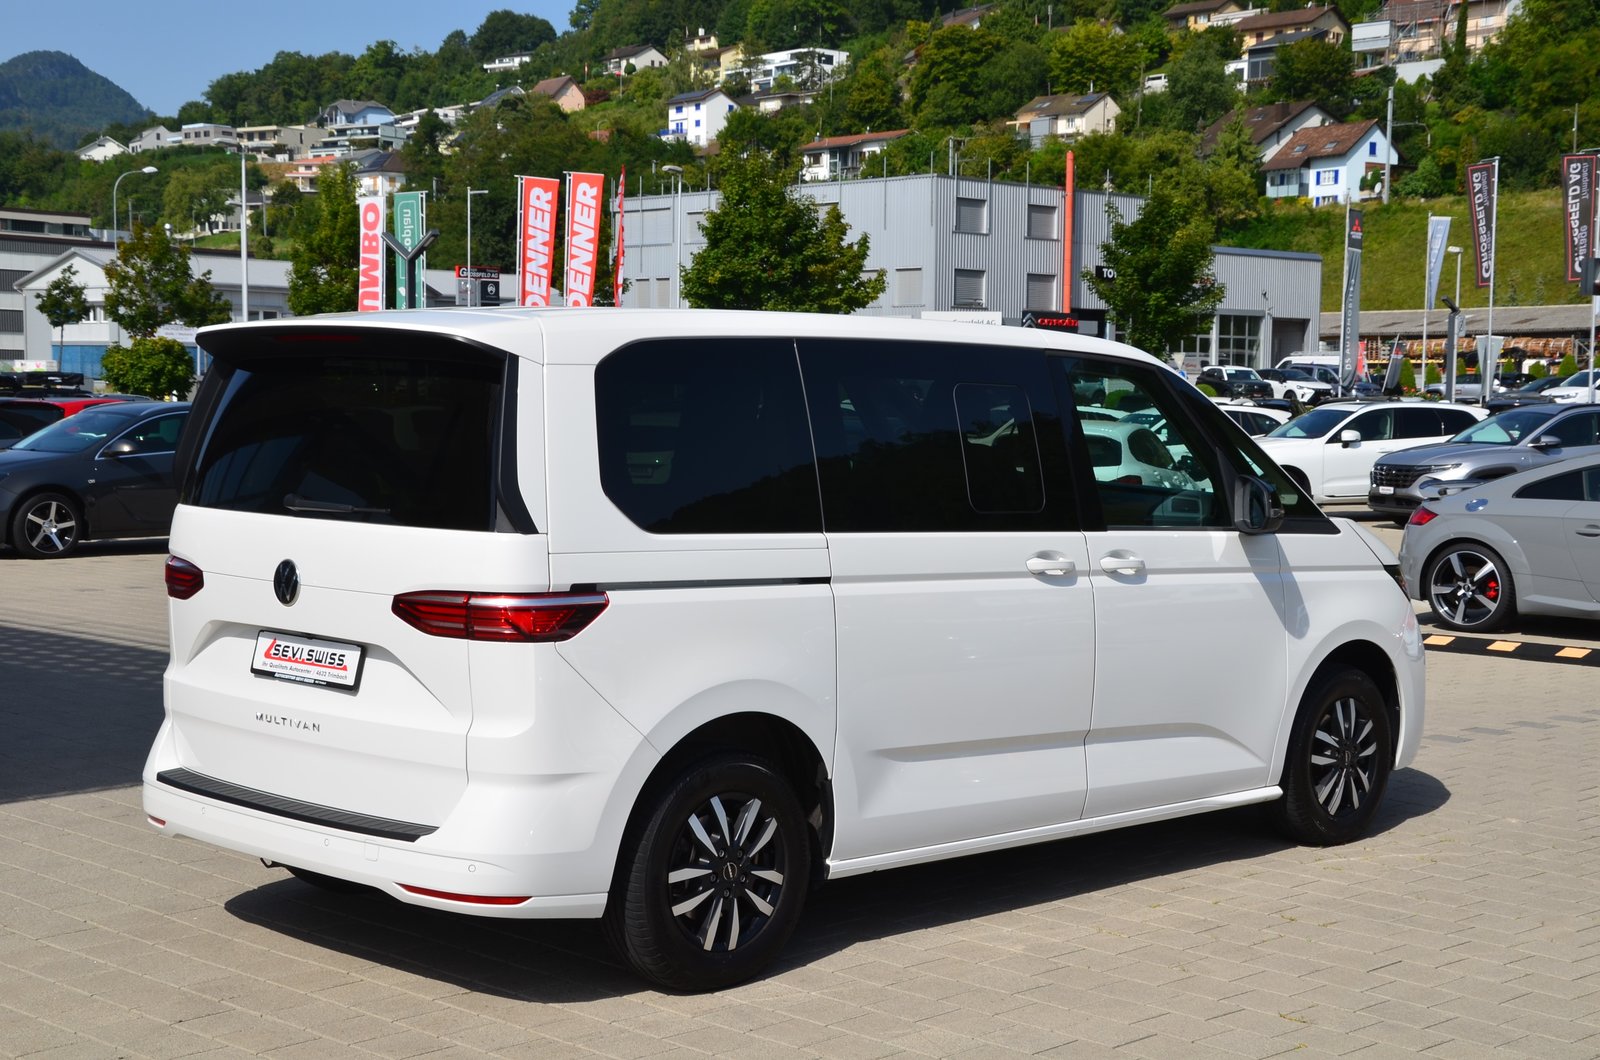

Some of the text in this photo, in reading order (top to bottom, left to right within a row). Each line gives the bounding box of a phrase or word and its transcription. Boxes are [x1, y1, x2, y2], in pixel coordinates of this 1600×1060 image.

[525, 187, 552, 306] DENNER
[567, 182, 597, 306] DENNER
[1102, 268, 1117, 278] TO
[306, 649, 346, 666] SWISS
[256, 712, 320, 732] MULTIVAN
